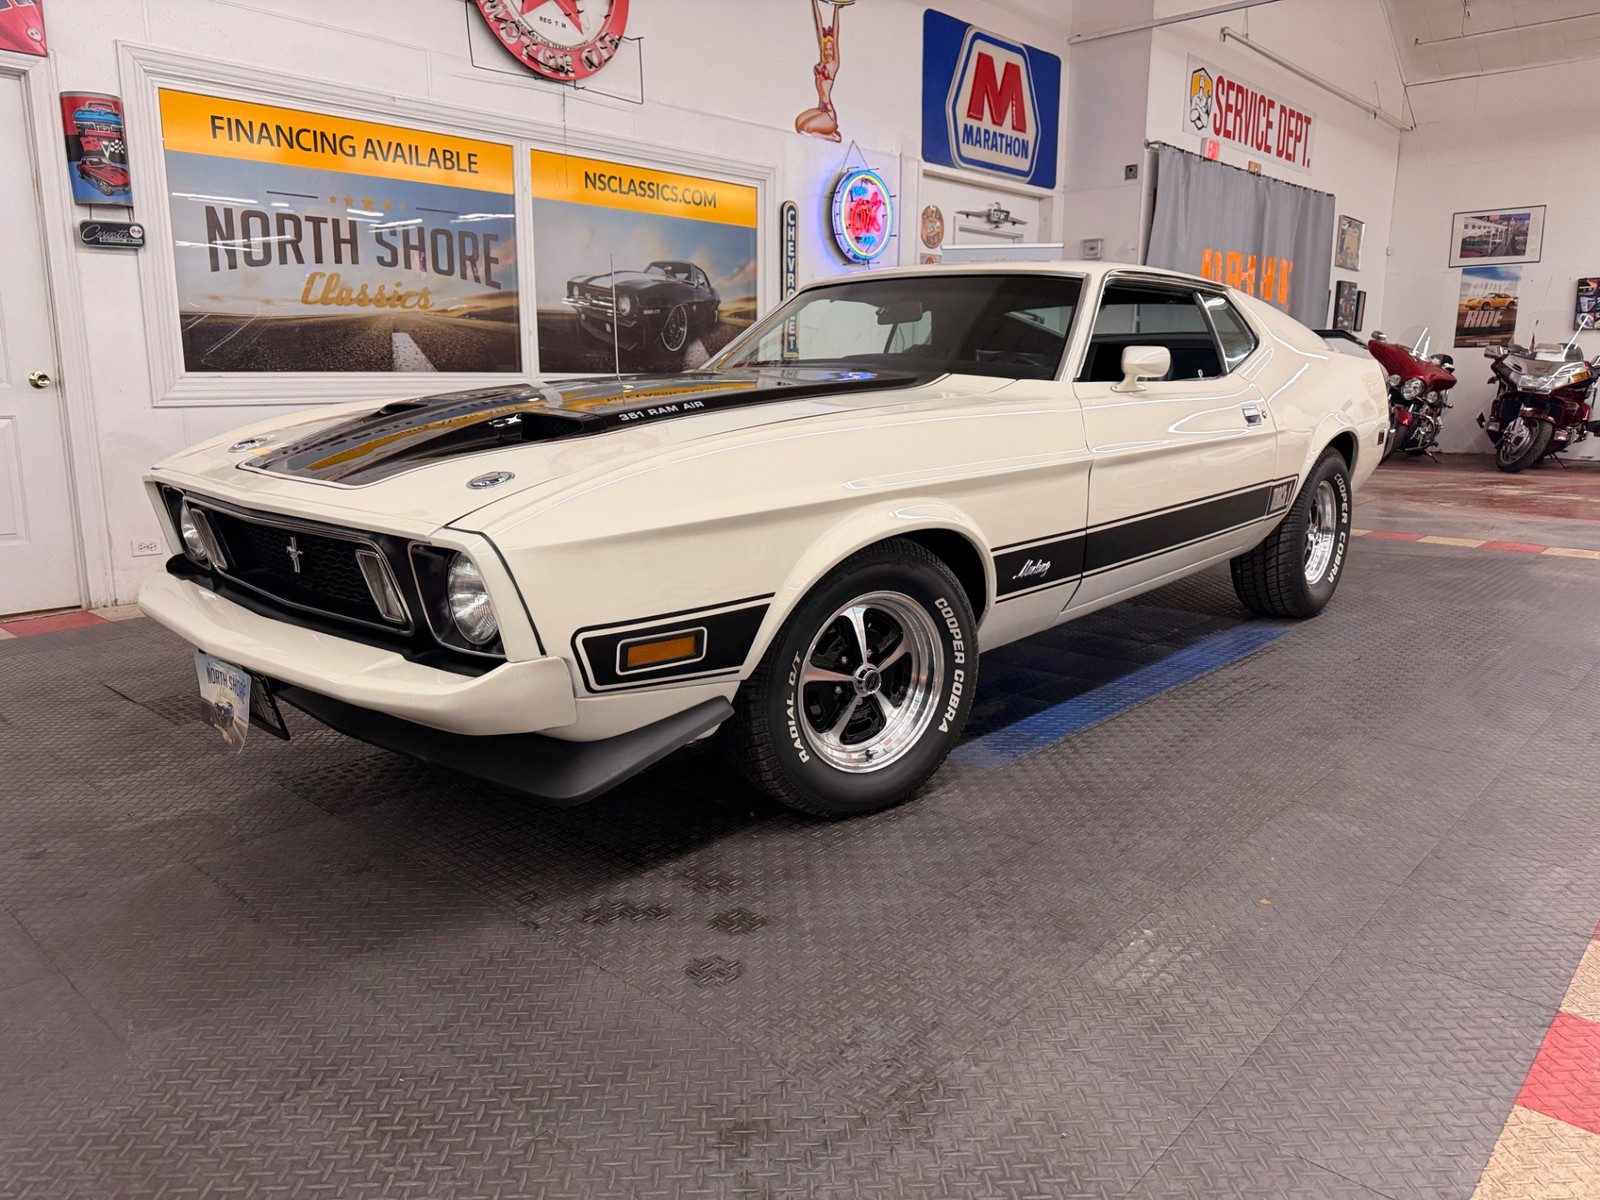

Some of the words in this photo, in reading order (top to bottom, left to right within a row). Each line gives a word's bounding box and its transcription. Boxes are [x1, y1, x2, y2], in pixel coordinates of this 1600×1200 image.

[539, 16, 552, 24] REG
[966, 51, 1027, 134] M
[210, 115, 356, 158] FINANCING
[363, 138, 479, 174] AVAILABLE
[962, 123, 1029, 160] MARATHON
[1213, 75, 1275, 154] SERVICE
[1276, 104, 1312, 168] DEPT.
[584, 171, 717, 209] NSCLASSICS.COM
[205, 205, 360, 272] NORTH
[375, 222, 501, 289] SHORE
[301, 271, 434, 310] Classics
[787, 210, 797, 350] CHEVROET
[1464, 310, 1503, 328] RIDE
[618, 410, 645, 422] 351
[647, 405, 679, 416] RAM
[683, 401, 705, 411] AIR
[1334, 473, 1348, 524] COOPER
[1327, 531, 1346, 583] COBRA
[934, 597, 965, 664] COOPER
[206, 665, 228, 688] NORTH
[938, 670, 965, 733] COBRA
[786, 692, 810, 763] RADIAL
